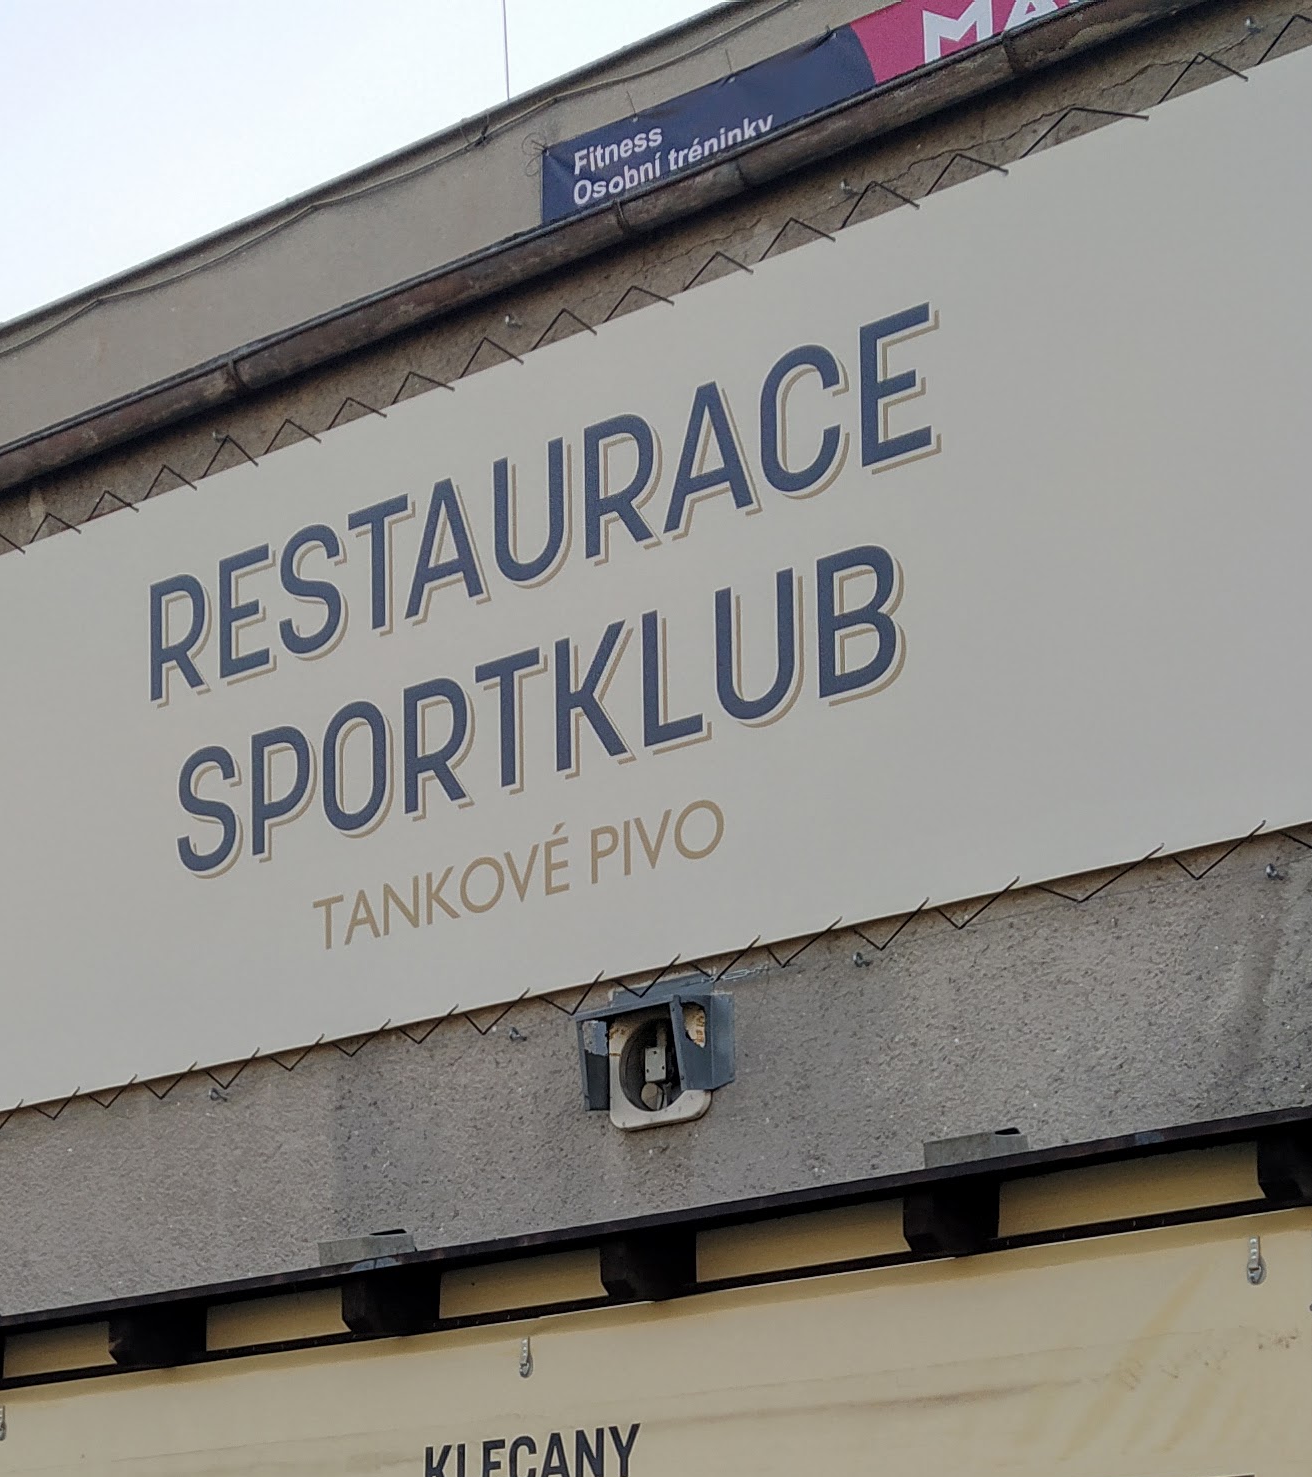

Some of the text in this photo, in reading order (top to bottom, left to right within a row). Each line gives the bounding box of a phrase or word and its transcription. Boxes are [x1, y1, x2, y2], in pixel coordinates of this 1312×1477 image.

[922, 0, 1080, 65] MA
[573, 127, 663, 176] Fitness
[573, 113, 775, 206] Osobní tréninky
[148, 302, 941, 708] RESTAURACE
[176, 543, 907, 879] SPORTKLUB
[312, 800, 726, 950] TANKOVÉ PIVO
